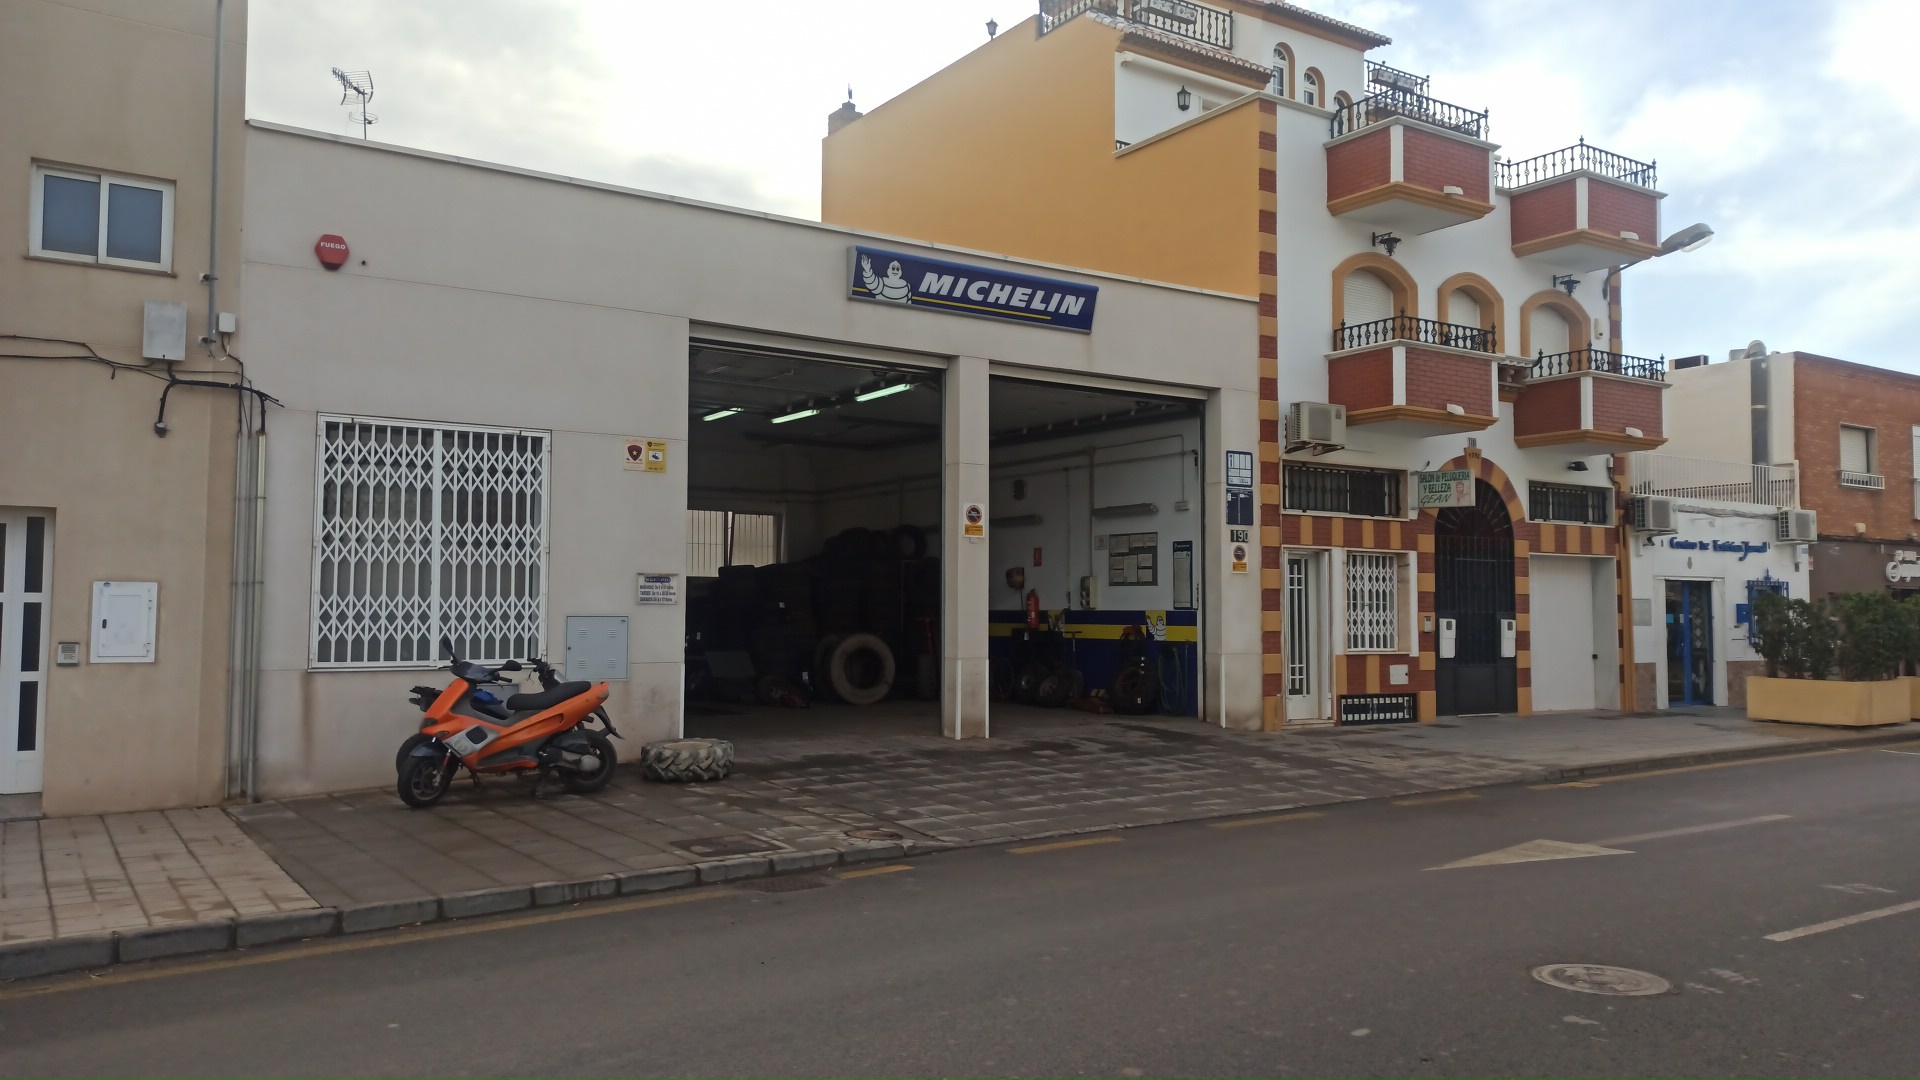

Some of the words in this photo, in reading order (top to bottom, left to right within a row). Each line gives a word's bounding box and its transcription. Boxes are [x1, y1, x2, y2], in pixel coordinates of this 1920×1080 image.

[320, 241, 346, 250] FUEGO
[918, 271, 1086, 316] MICHELIN
[1428, 482, 1451, 494] BELLEZA
[1233, 530, 1248, 542] 190
